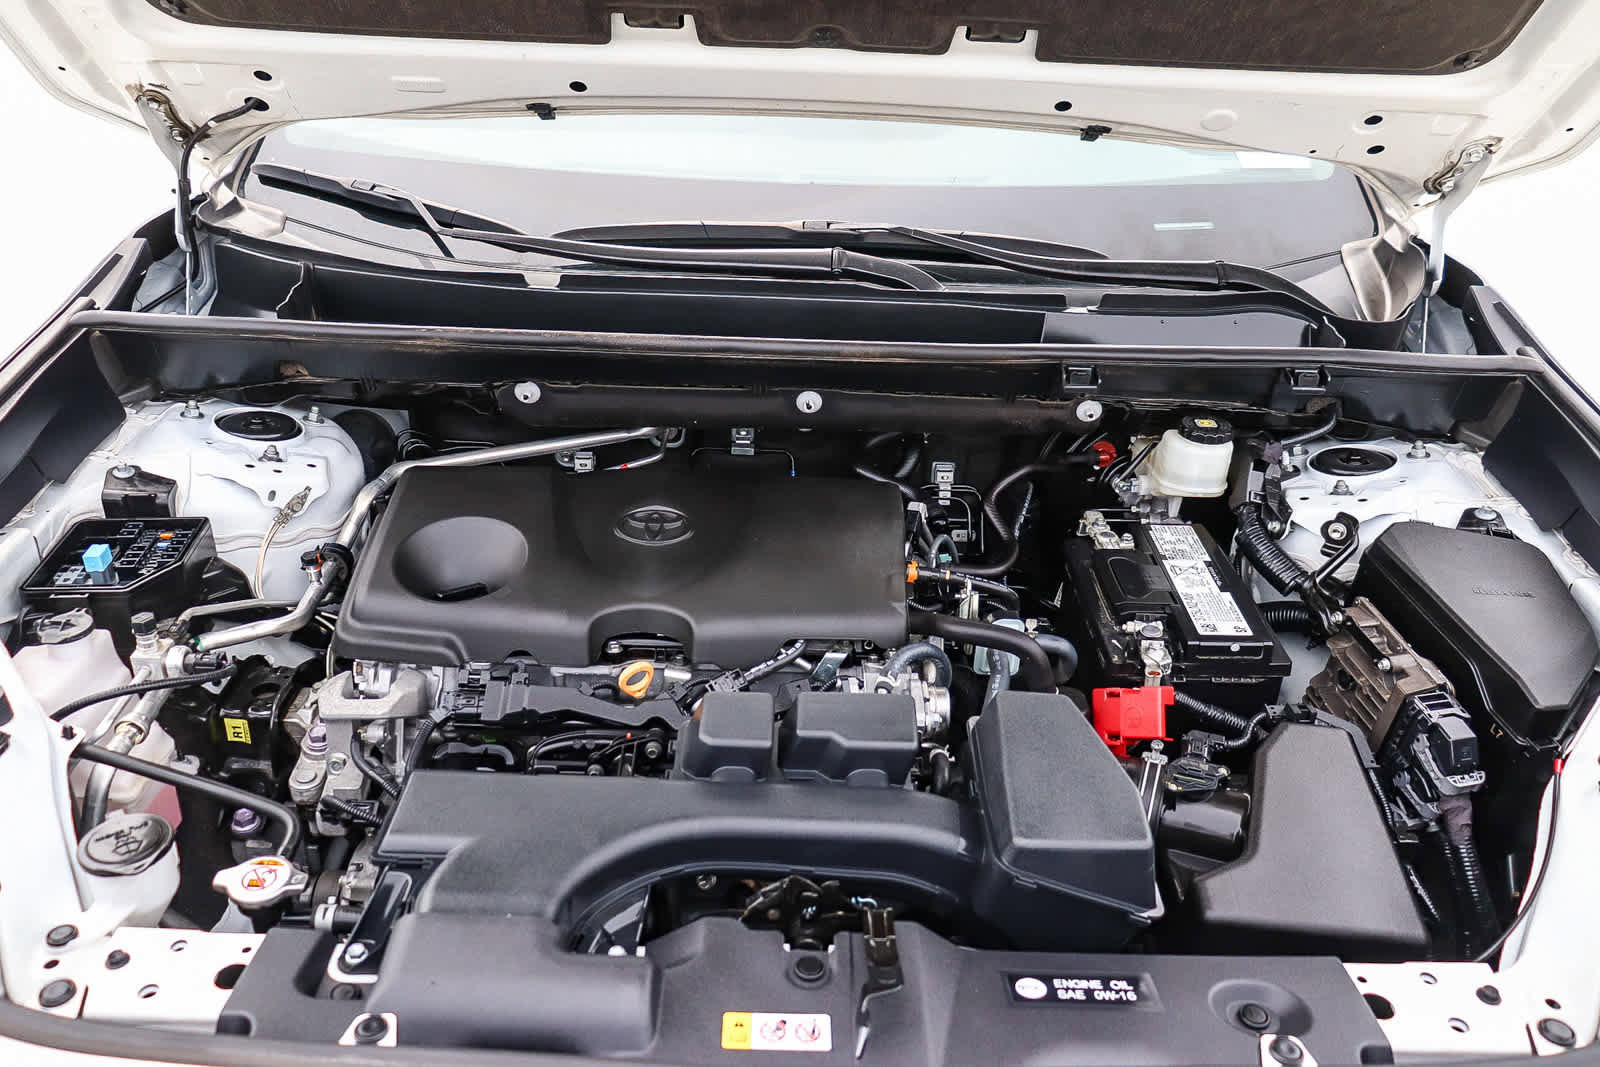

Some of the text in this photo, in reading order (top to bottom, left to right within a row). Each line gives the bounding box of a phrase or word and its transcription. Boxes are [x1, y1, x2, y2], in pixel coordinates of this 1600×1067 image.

[232, 726, 243, 738] R1
[1053, 979, 1103, 990] ENGINE
[1110, 979, 1134, 991] OIL
[1057, 990, 1137, 1001] SAE 0W-16
